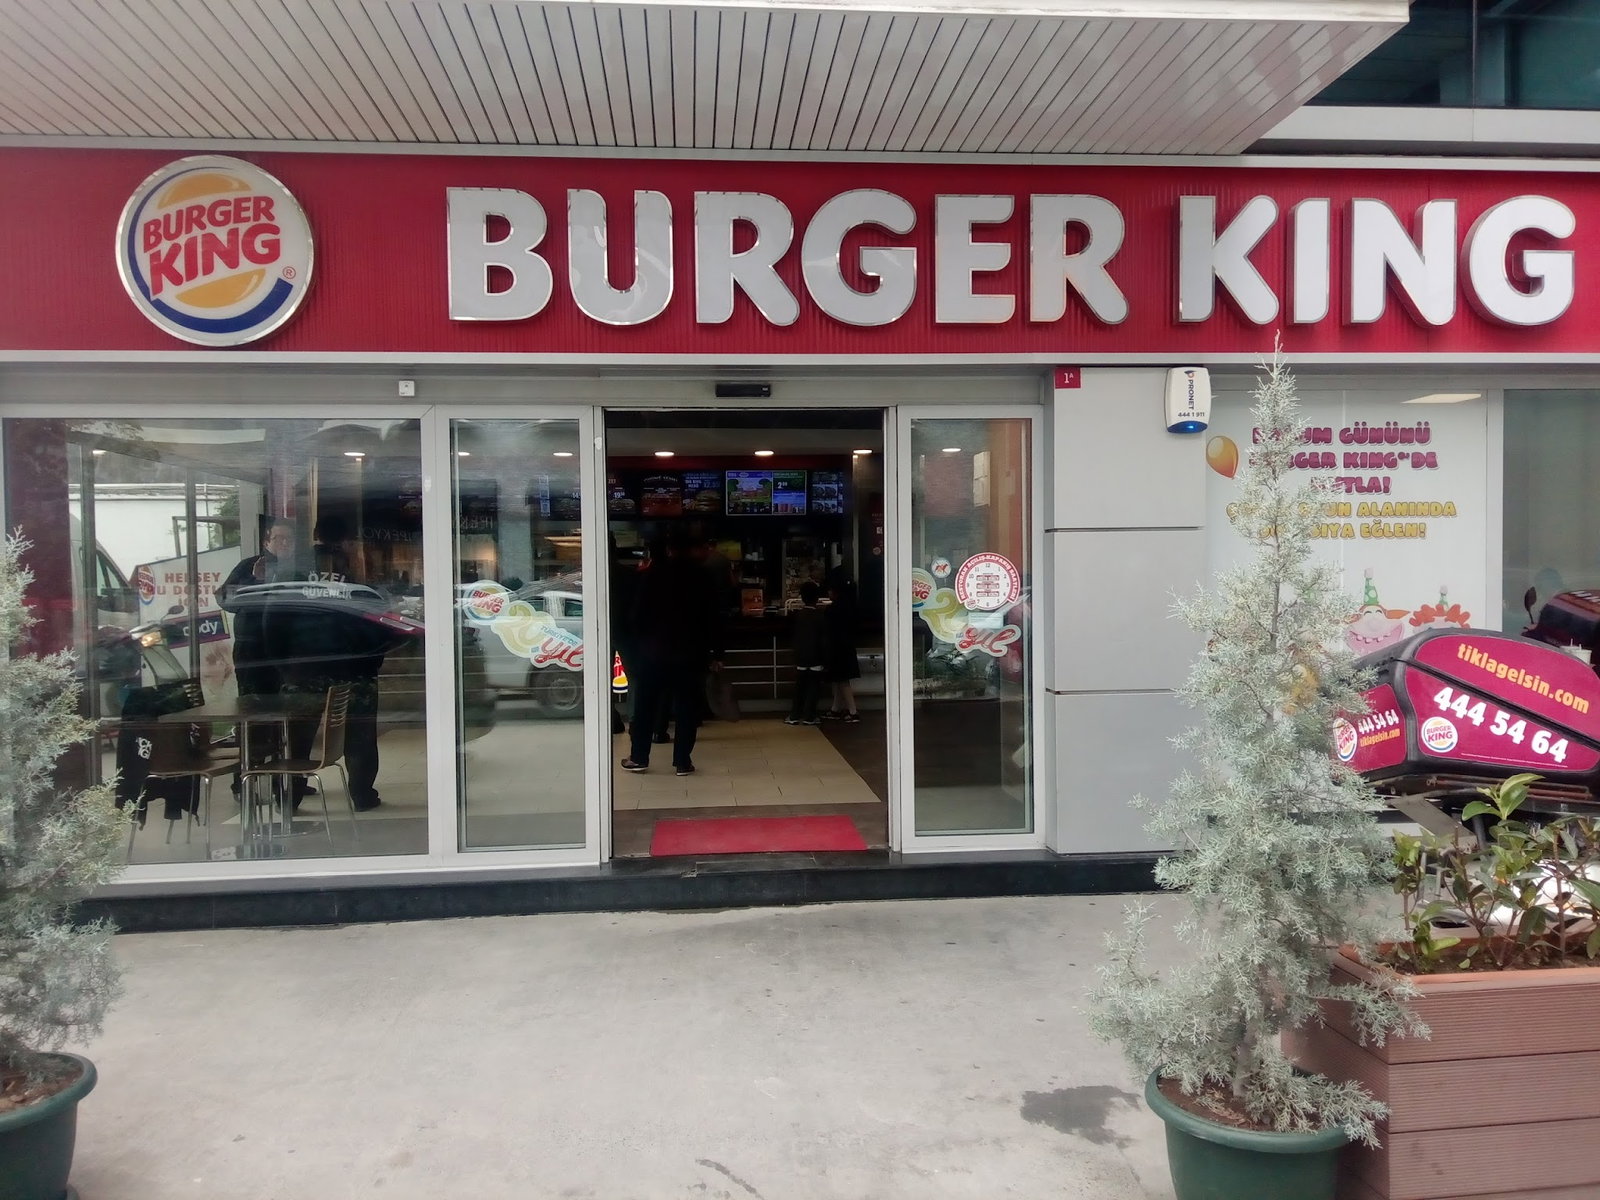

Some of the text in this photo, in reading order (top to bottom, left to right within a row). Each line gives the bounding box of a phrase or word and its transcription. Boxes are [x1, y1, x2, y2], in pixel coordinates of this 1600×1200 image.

[143, 196, 276, 254] BURGER
[150, 223, 281, 296] KING
[447, 186, 1577, 327] BURGER KING
[1339, 421, 1432, 445] GÜNÜNÜ
[1357, 501, 1458, 517] ALANINDA
[1361, 518, 1427, 539] EĞLEN!
[1457, 643, 1590, 714] tiklagelsin.com
[1358, 708, 1399, 735] 444 54 64
[1427, 725, 1451, 735] BURGER
[1434, 686, 1487, 727] 444
[1489, 710, 1527, 745] 54
[1531, 730, 1569, 763] 64
[1428, 731, 1453, 743] KING
